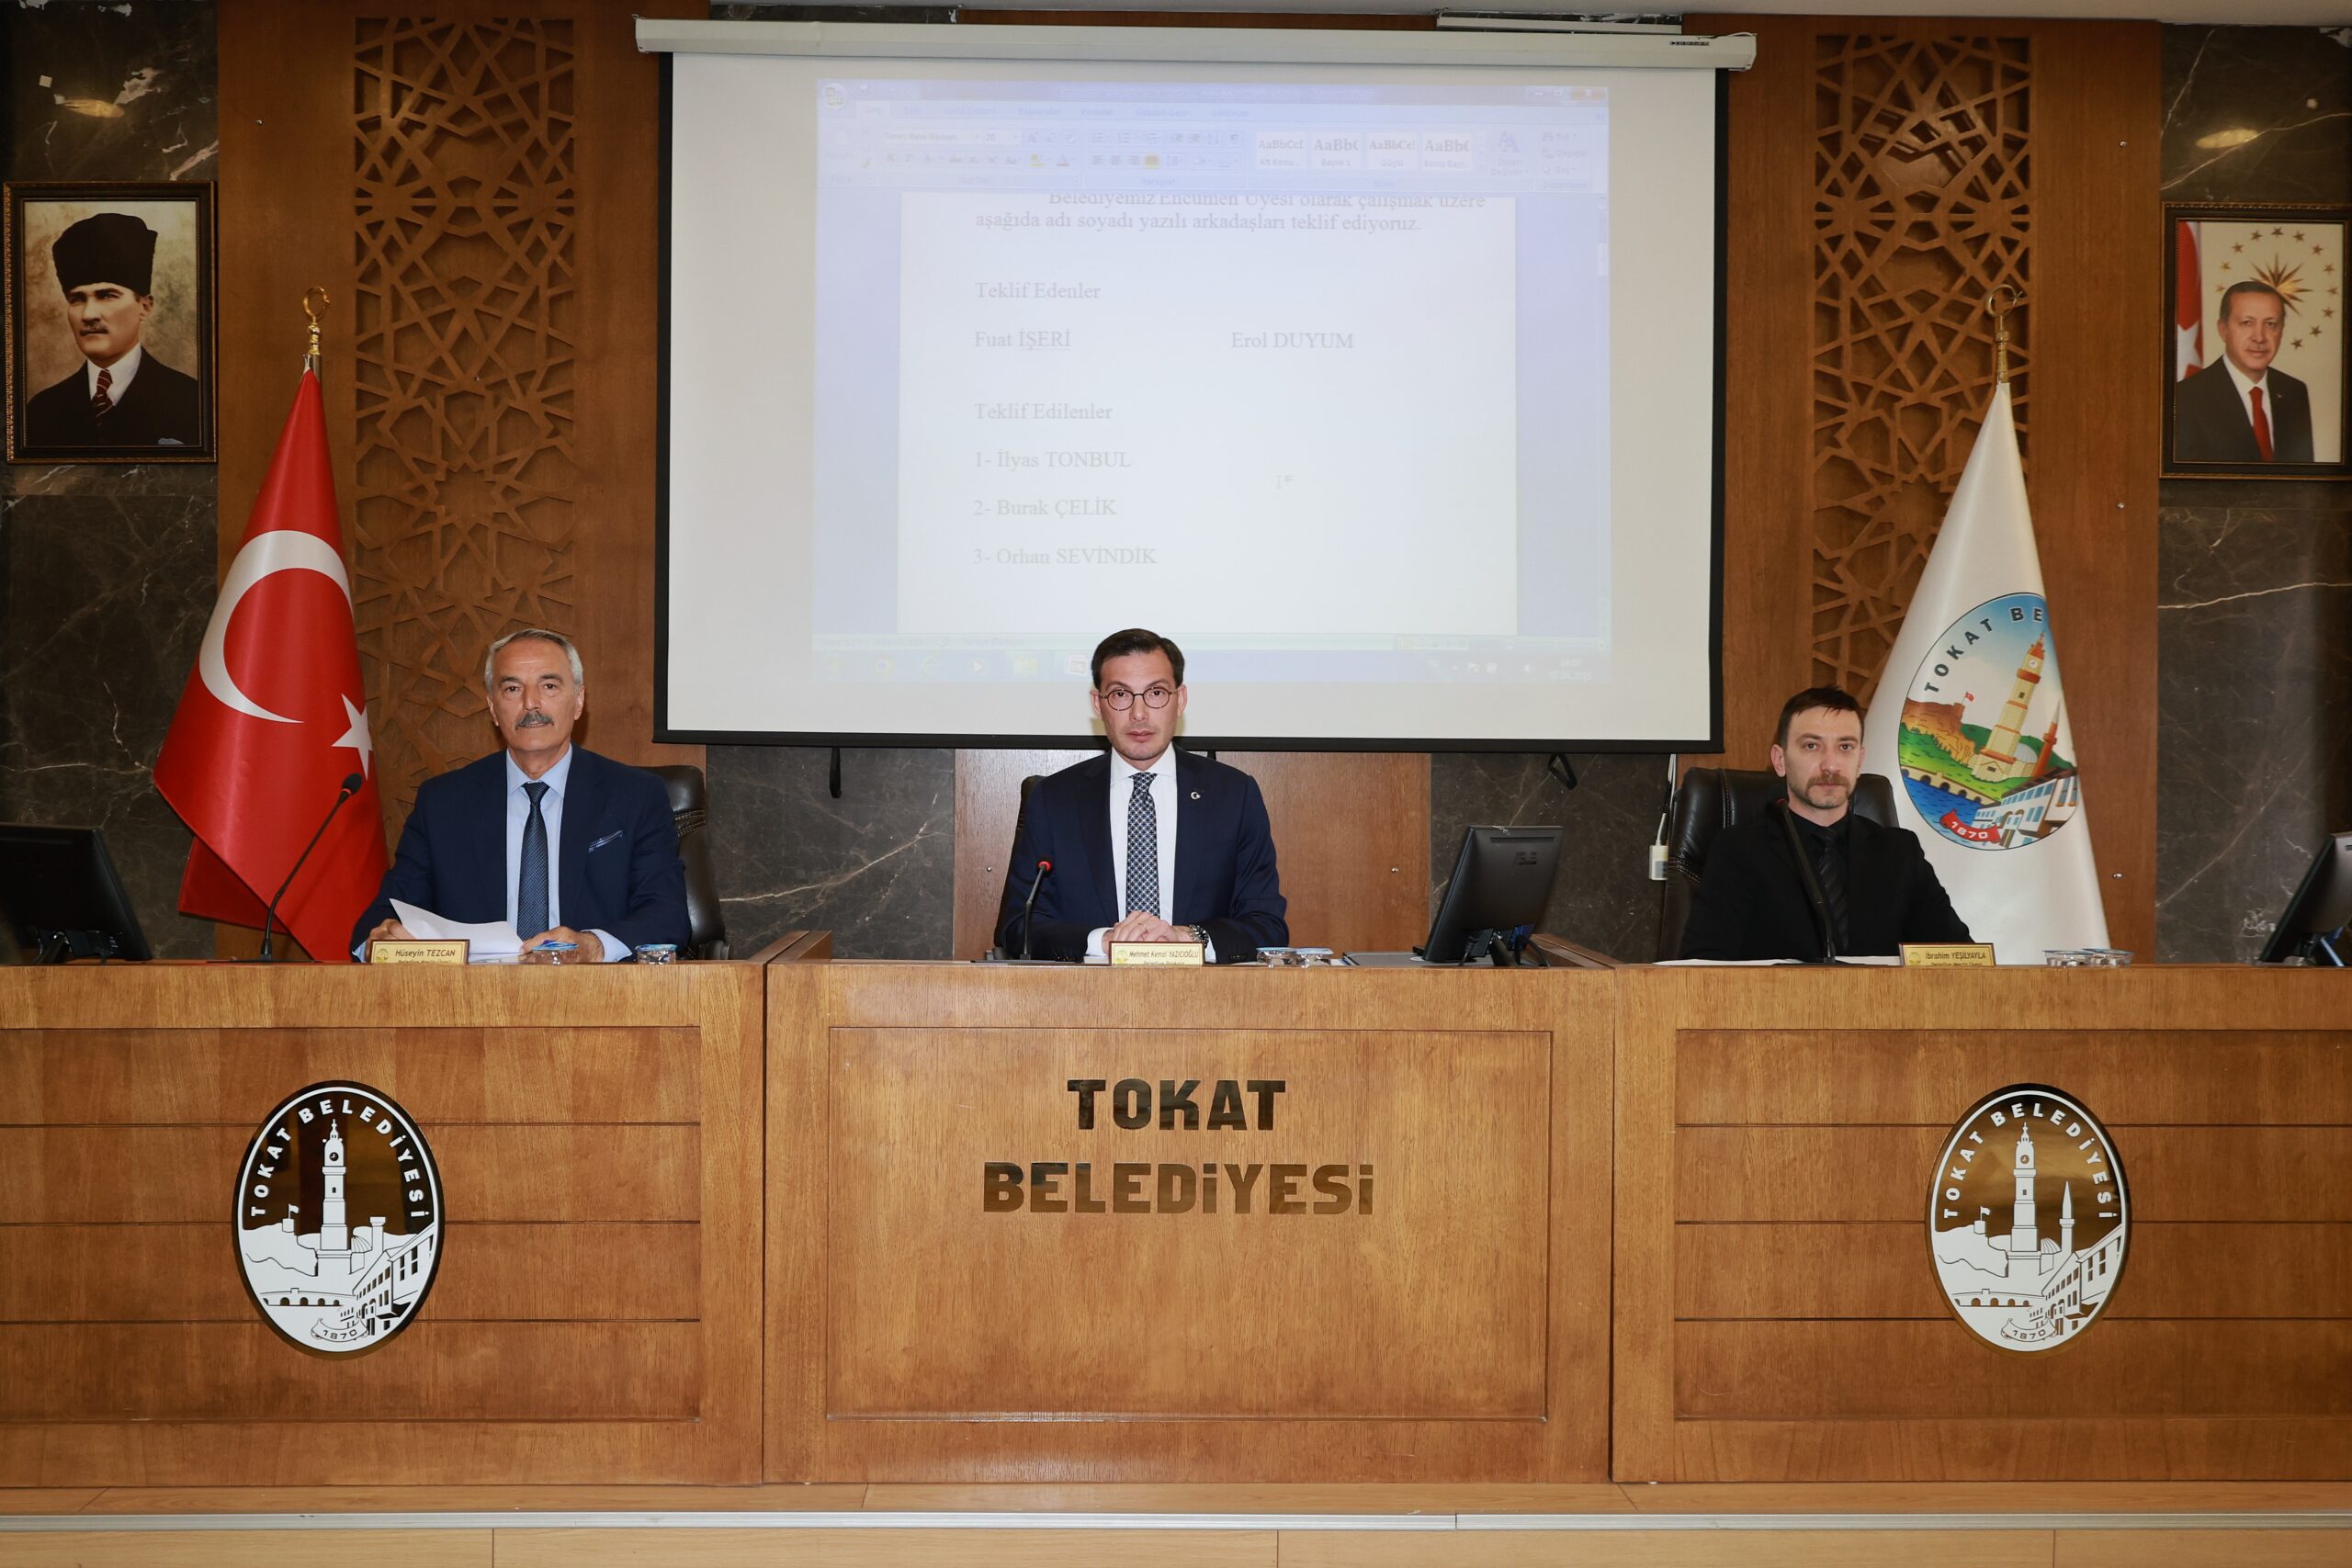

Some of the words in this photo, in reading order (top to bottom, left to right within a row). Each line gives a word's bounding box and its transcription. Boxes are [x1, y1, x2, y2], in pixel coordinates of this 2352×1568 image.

[976, 211, 1040, 231] aşağıda
[1045, 211, 1071, 228] adı
[1077, 211, 1134, 231] soyadı
[1139, 212, 1187, 232] yazılı
[1193, 212, 1285, 233] arkadaşları
[1291, 213, 1339, 230] teklif
[976, 281, 1031, 299] Teklif
[1034, 281, 1102, 299] Edenler
[975, 331, 1012, 348] Fuat
[1018, 328, 1071, 351] İŞERİ
[1231, 332, 1268, 348] Erol
[1273, 332, 1354, 349] DUYUM
[976, 402, 1030, 419] Teklif
[1033, 402, 1113, 420] Edilenler
[976, 451, 992, 468] 1-
[997, 448, 1040, 471] İlyas
[1045, 451, 1132, 468] TONBUL
[974, 500, 991, 515] 2-
[997, 499, 1049, 516] Burak
[1055, 497, 1117, 519] ÇELİK
[974, 548, 991, 564] 3-
[997, 547, 1050, 565] Orhan
[1056, 545, 1158, 565] SEVİNDİK
[1924, 617, 1994, 693] TOKAT
[1950, 820, 1988, 840] 1870
[395, 949, 424, 958] Hüseyin
[1926, 951, 1950, 960] İbrahim
[1067, 1079, 1286, 1131] TOKAT
[251, 1126, 293, 1217] TOKAT
[299, 1098, 430, 1218] BELEDİYESİ
[1944, 1131, 1985, 1220] TOKAT
[1990, 1102, 2118, 1220] BELEDİYESİ
[983, 1162, 1374, 1215] BELEDİYESİ
[322, 1327, 359, 1342] 1870
[2011, 1328, 2048, 1342] 1870
